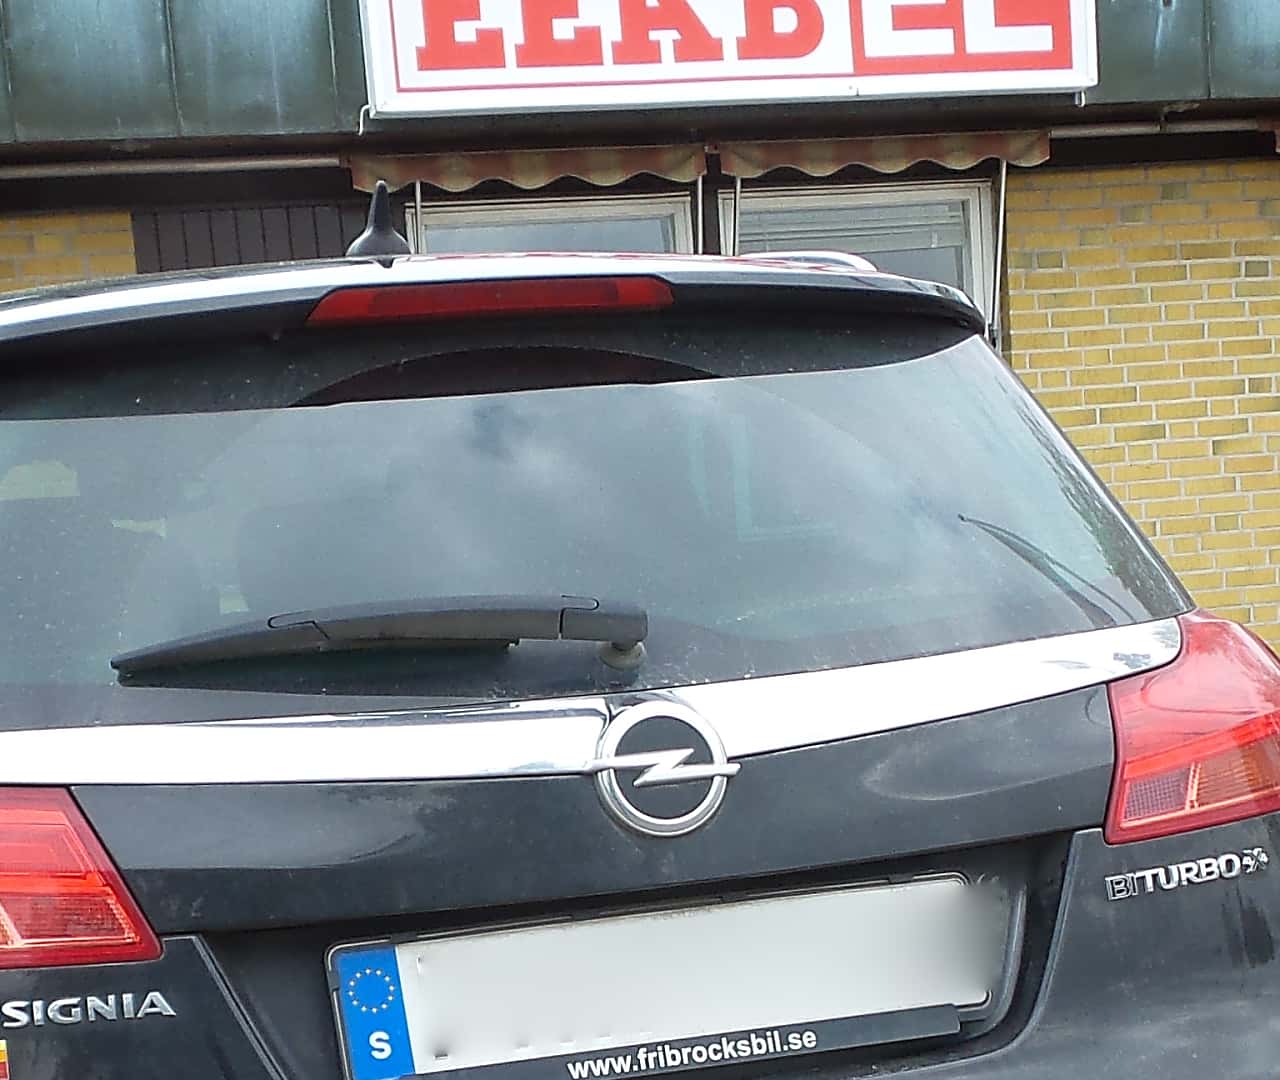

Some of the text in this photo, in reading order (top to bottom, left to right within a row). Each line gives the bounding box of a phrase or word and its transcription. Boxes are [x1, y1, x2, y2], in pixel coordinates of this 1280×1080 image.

[1104, 852, 1241, 901] BITURBO
[368, 1030, 393, 1061] S
[566, 1030, 818, 1080] www.fribrocksbil.se
